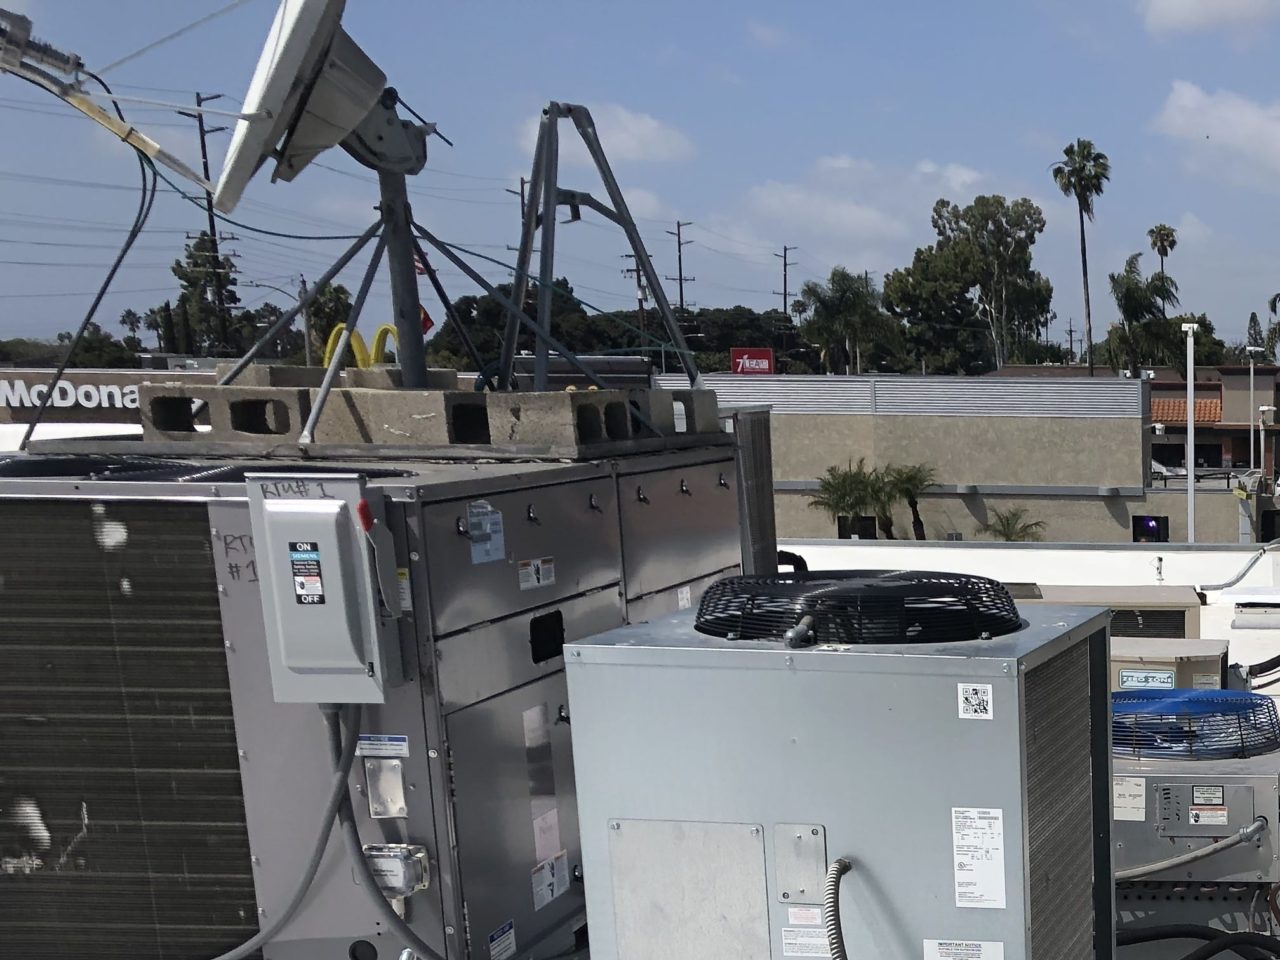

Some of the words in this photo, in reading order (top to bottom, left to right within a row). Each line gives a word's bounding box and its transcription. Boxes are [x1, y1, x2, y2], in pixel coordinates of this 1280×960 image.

[317, 482, 335, 499] 1
[296, 543, 311, 551] ON
[301, 595, 320, 603] OFF
